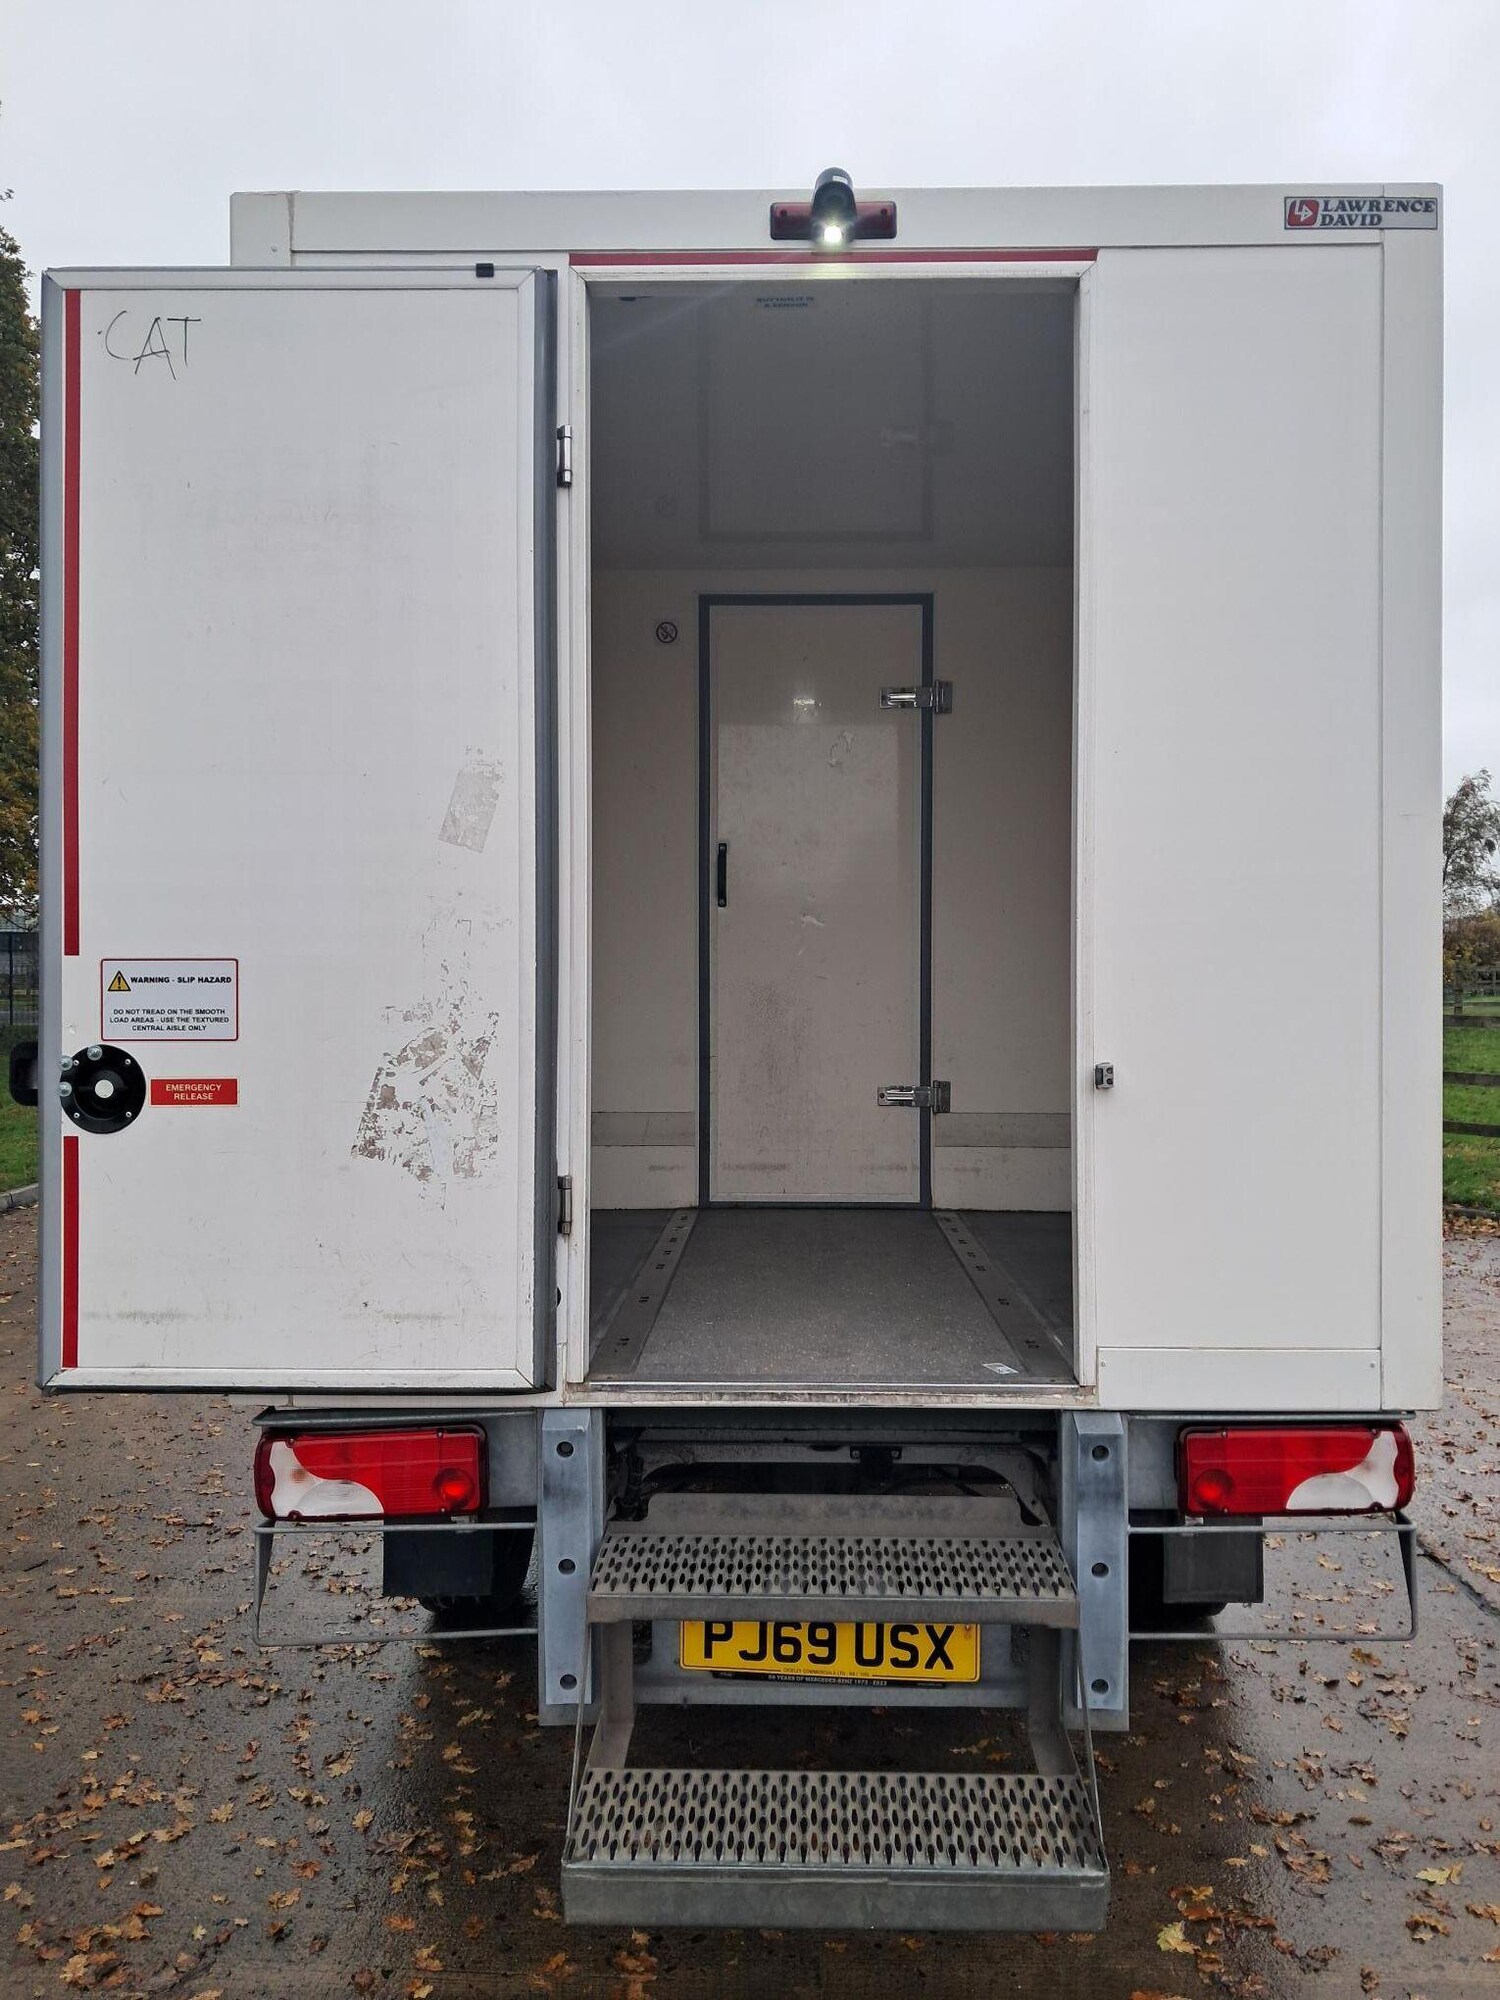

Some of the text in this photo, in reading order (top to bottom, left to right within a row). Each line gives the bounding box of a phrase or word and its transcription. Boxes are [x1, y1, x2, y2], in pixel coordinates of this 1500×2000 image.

[1321, 199, 1436, 213] LAWRENCE
[1319, 213, 1383, 227] DAVID
[105, 310, 202, 381] CAT
[130, 976, 170, 984] WARNING
[177, 976, 196, 984] SLIP
[197, 976, 232, 984] HAZARD
[165, 1083, 222, 1092] EMERGENCY
[173, 1092, 214, 1100] RELEASE
[703, 1621, 955, 1671] PJ69 USX
